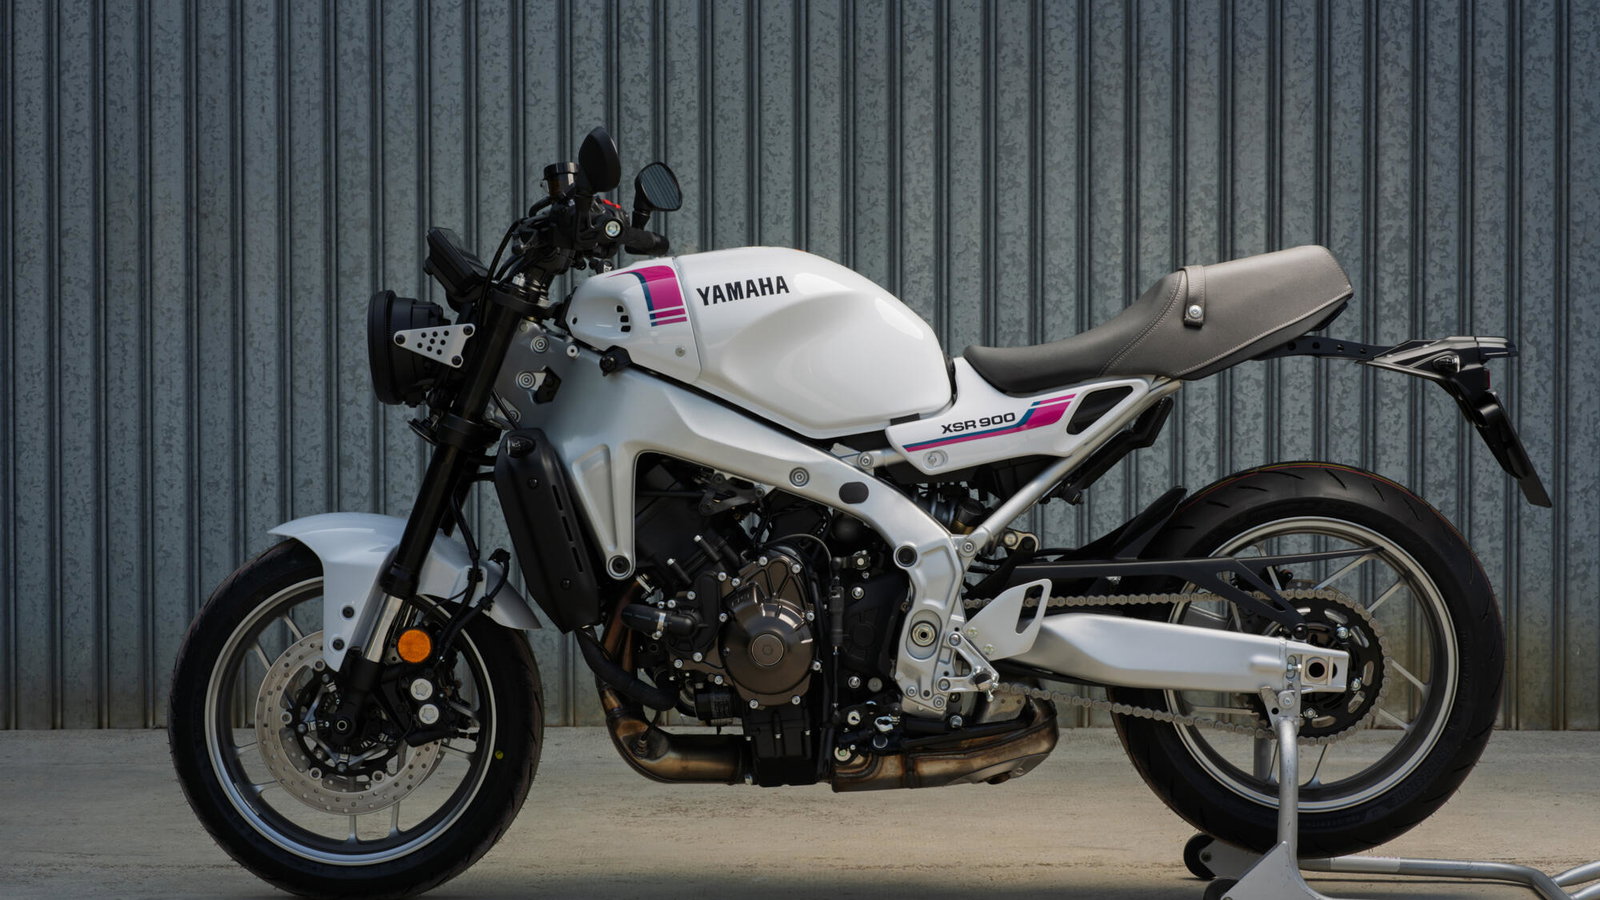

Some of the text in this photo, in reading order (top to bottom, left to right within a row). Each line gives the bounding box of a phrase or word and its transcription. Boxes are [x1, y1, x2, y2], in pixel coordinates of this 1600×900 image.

[696, 275, 790, 306] YAMAHA
[942, 412, 1016, 434] XSR 900
